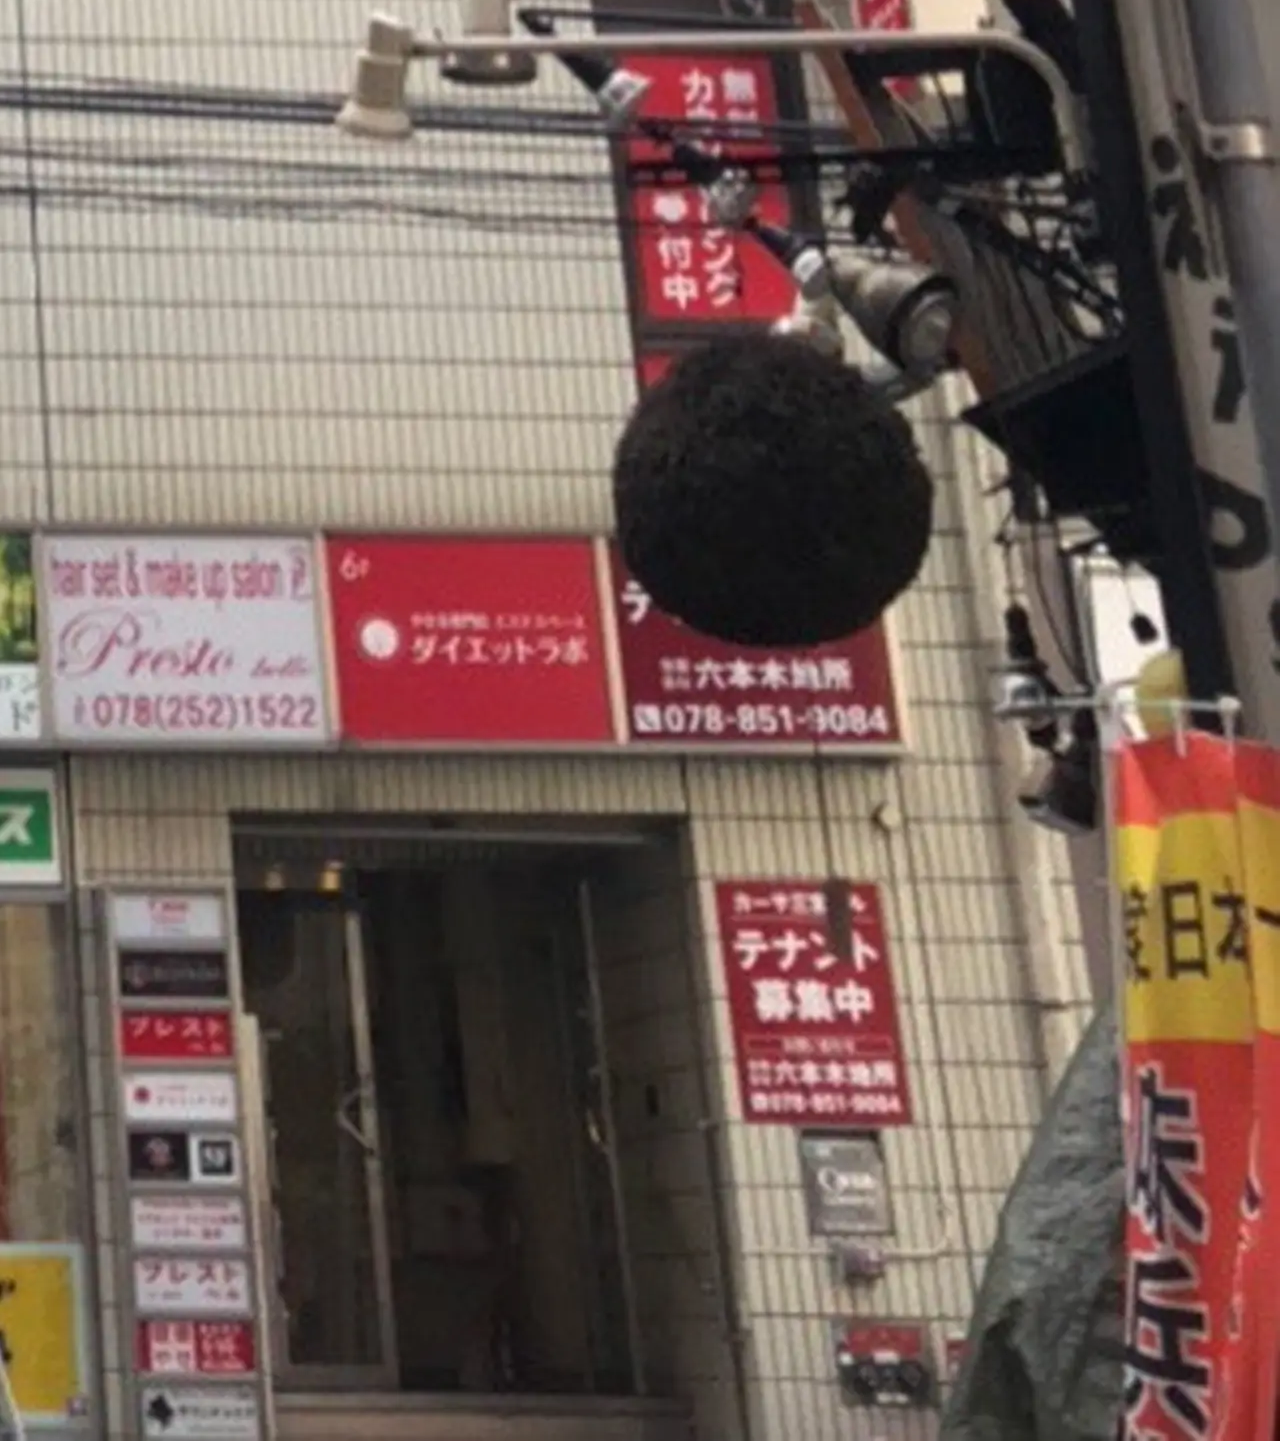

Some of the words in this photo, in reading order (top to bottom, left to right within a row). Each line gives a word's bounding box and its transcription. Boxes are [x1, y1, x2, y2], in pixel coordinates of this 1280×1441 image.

[411, 635, 589, 664] ダイエットラボ
[663, 704, 890, 736] 078-851-9084
[733, 928, 880, 973] テナント
